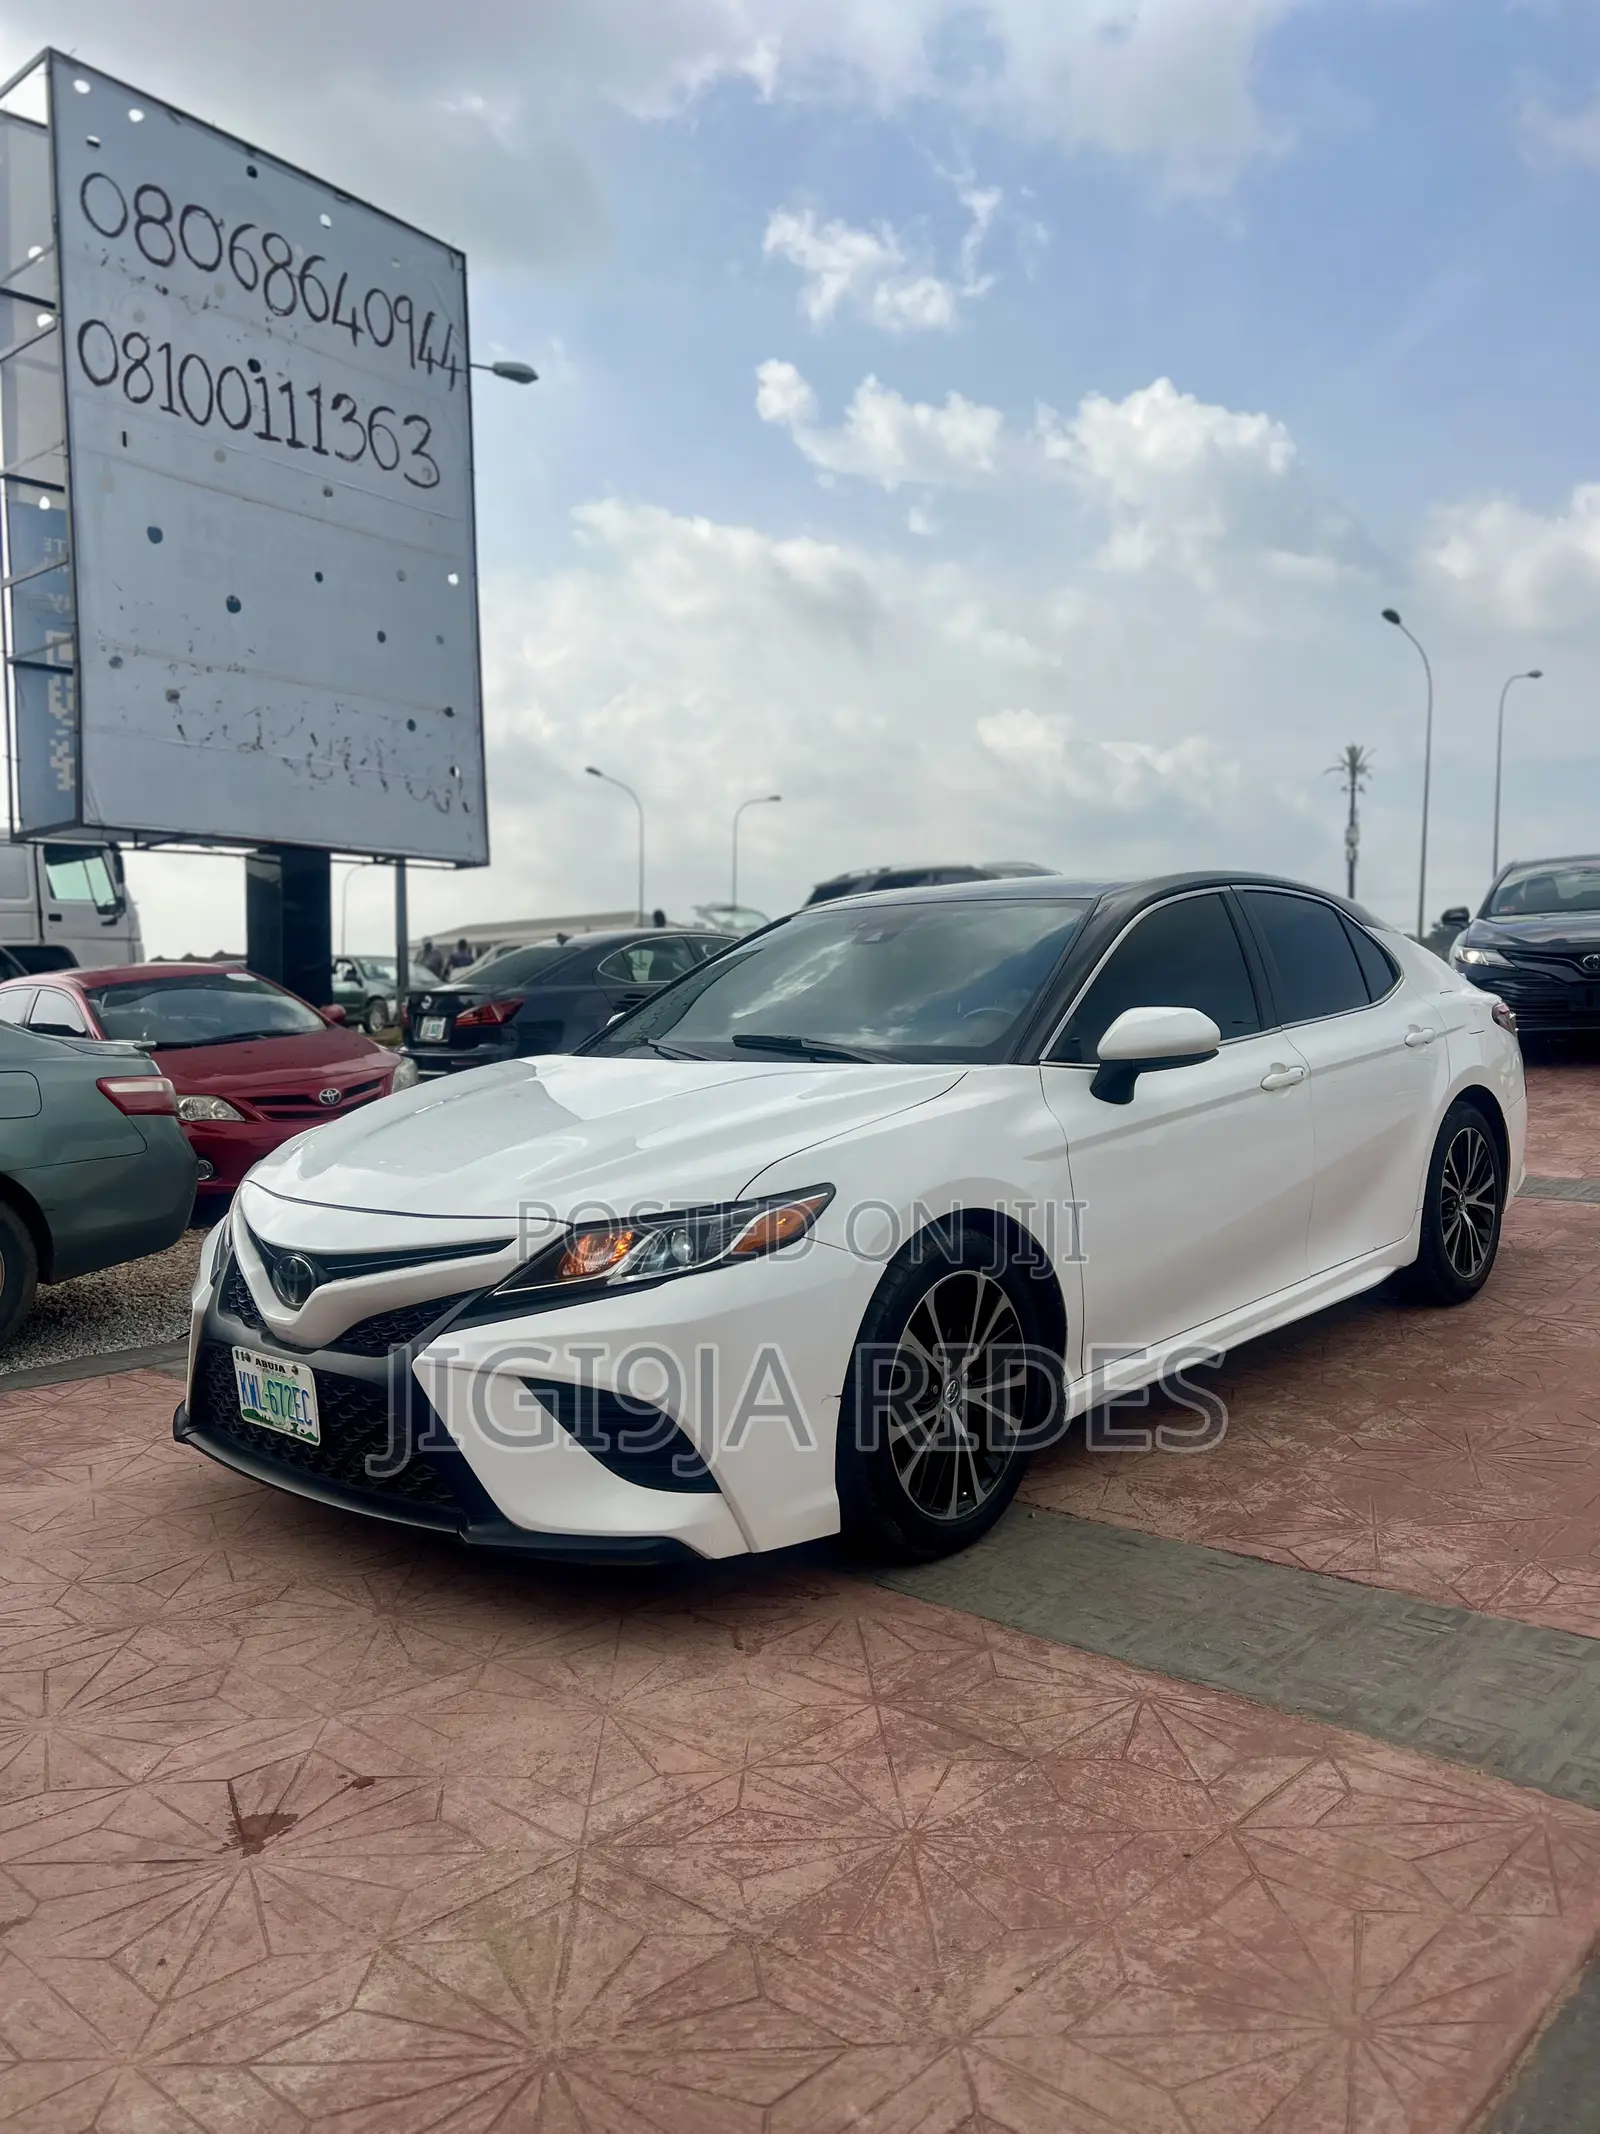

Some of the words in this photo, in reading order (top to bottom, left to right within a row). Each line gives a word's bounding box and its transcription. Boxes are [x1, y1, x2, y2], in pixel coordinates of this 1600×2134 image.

[80, 172, 467, 392] 08068640944
[77, 319, 441, 489] 08100111363
[255, 1358, 286, 1374] ABUJA
